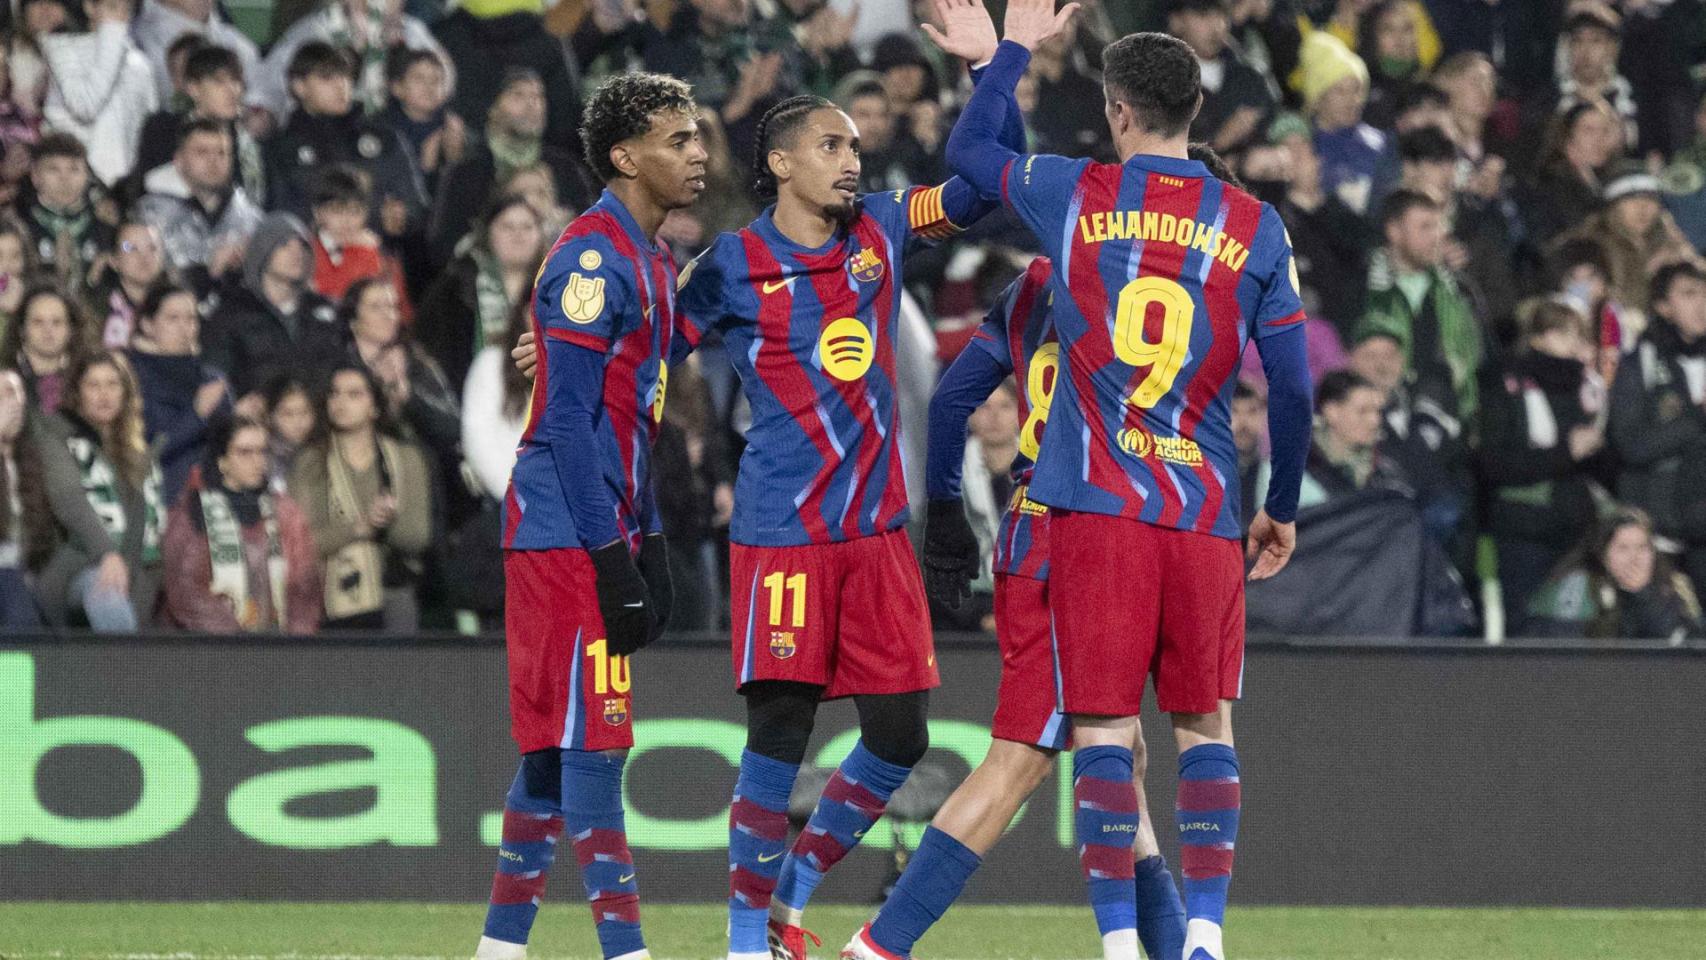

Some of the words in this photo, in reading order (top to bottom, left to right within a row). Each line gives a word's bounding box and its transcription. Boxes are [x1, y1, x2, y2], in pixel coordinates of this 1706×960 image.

[1079, 211, 1249, 272] LEWANDOWSKI
[1113, 276, 1195, 408] 9
[1154, 444, 1203, 461] ACNUR
[763, 571, 807, 628] 11
[586, 638, 631, 694] 10
[1179, 822, 1220, 832] BARÇA
[499, 848, 524, 863] ARÇA
